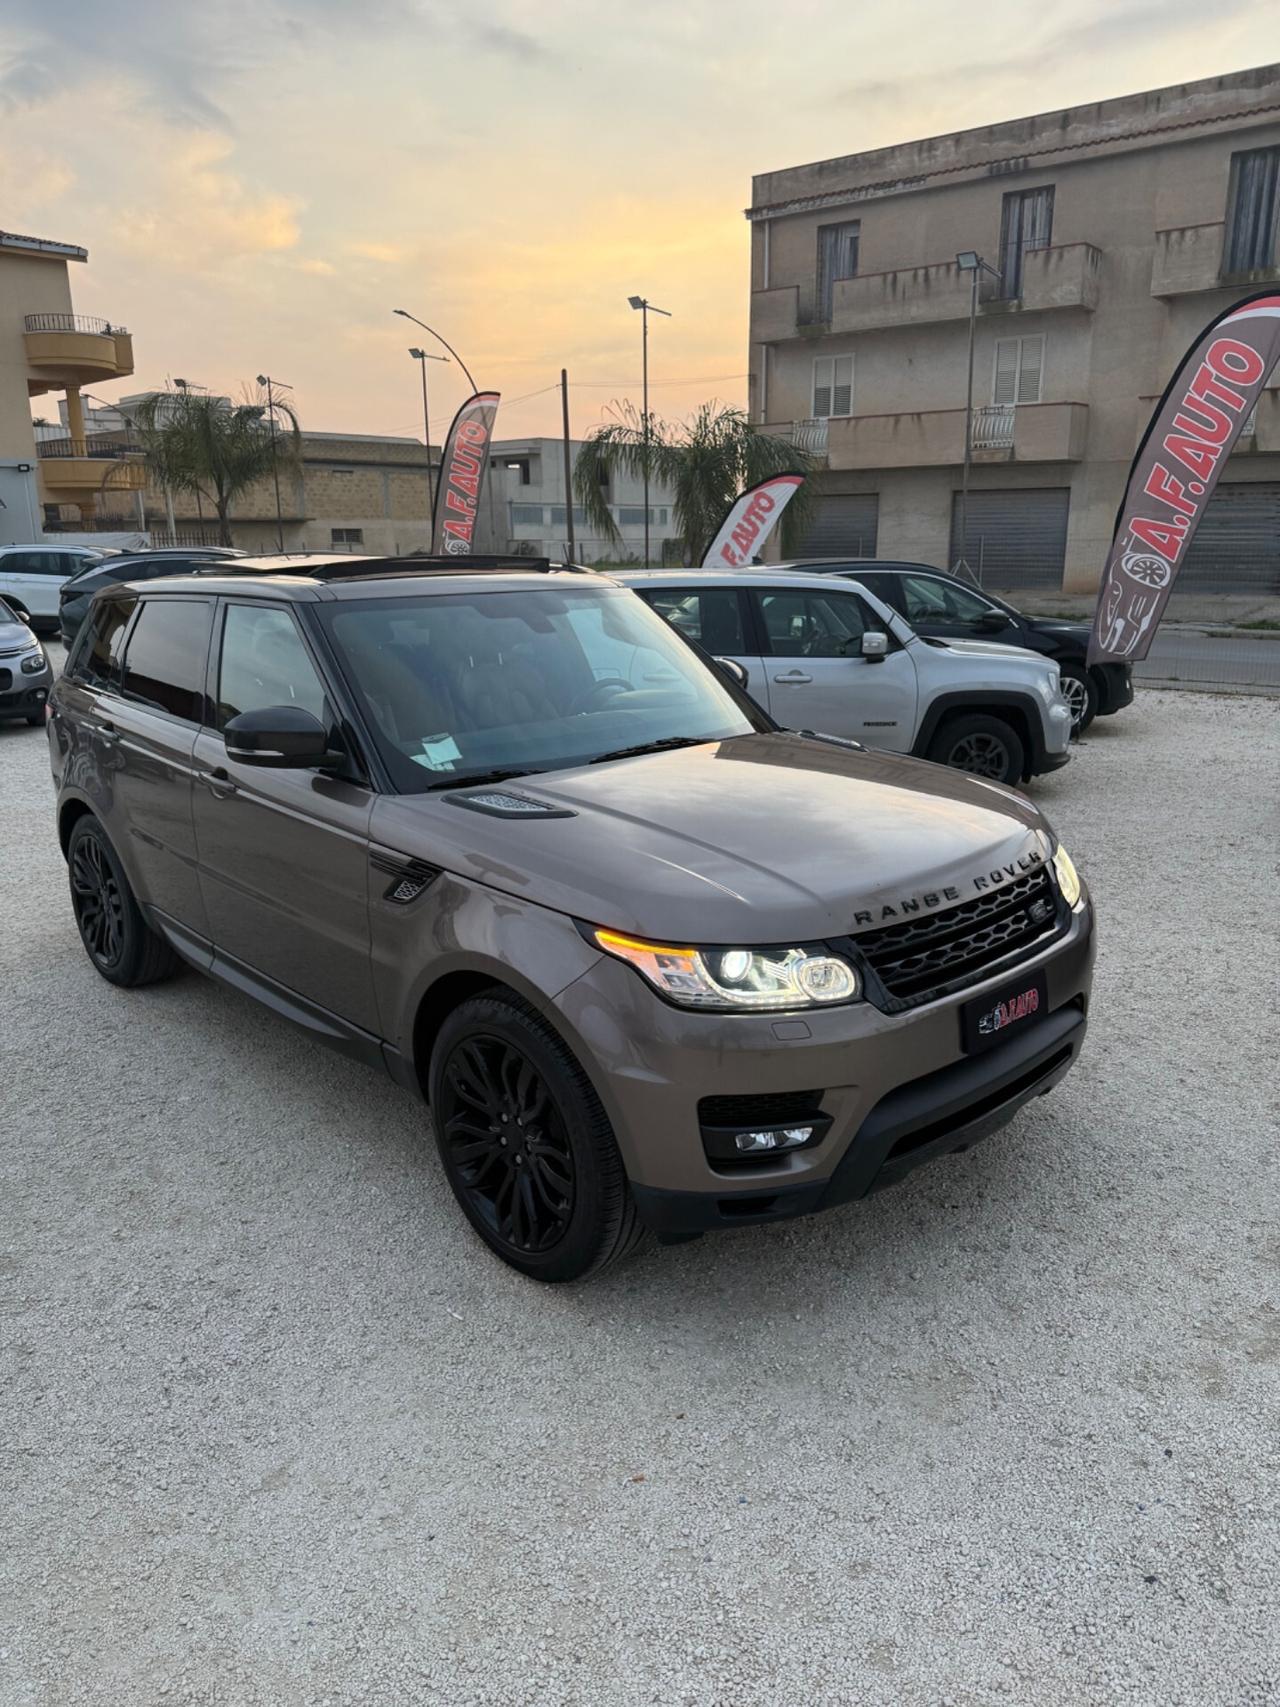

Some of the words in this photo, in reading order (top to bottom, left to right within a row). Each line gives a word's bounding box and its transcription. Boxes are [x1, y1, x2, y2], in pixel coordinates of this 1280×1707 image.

[443, 419, 488, 544] A.F.AUTO
[1128, 338, 1265, 563] A.F.AUTO
[853, 885, 960, 926] RANGE
[973, 850, 1042, 892] ROVER
